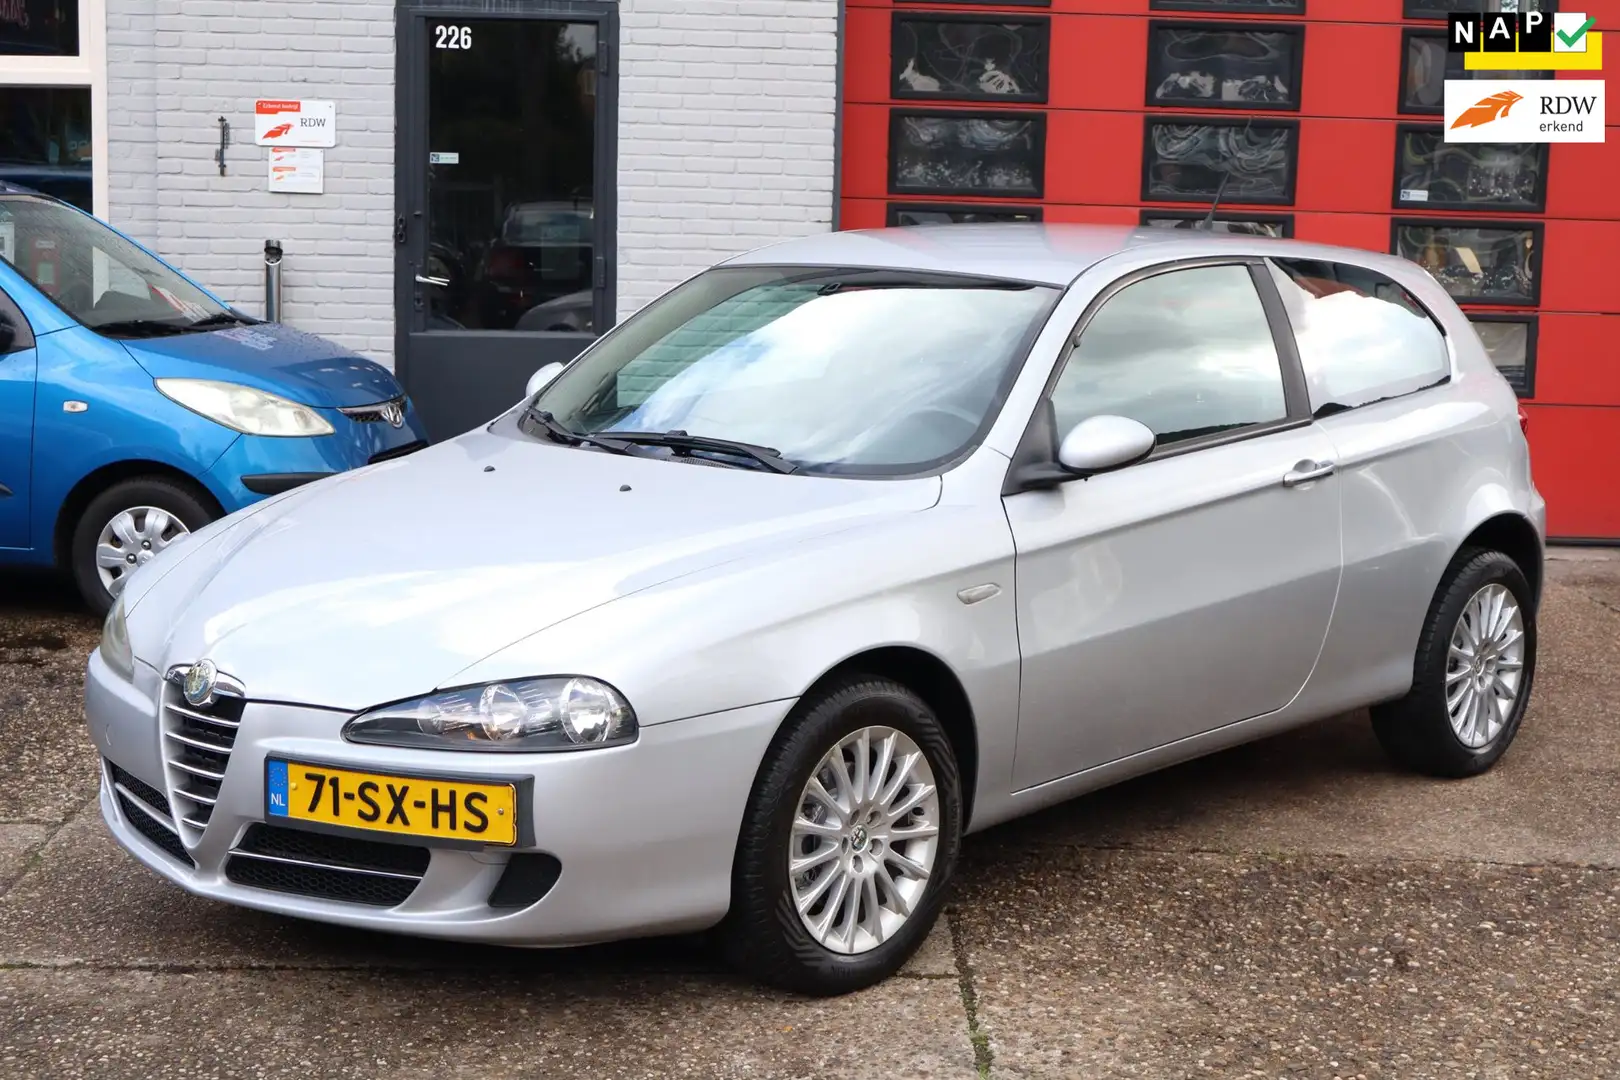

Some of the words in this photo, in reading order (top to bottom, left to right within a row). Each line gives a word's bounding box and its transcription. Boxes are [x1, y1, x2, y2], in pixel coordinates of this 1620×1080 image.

[435, 25, 472, 49] 226
[300, 117, 326, 128] RDW
[270, 792, 286, 807] NL
[304, 772, 489, 833] 71-SX-HS
